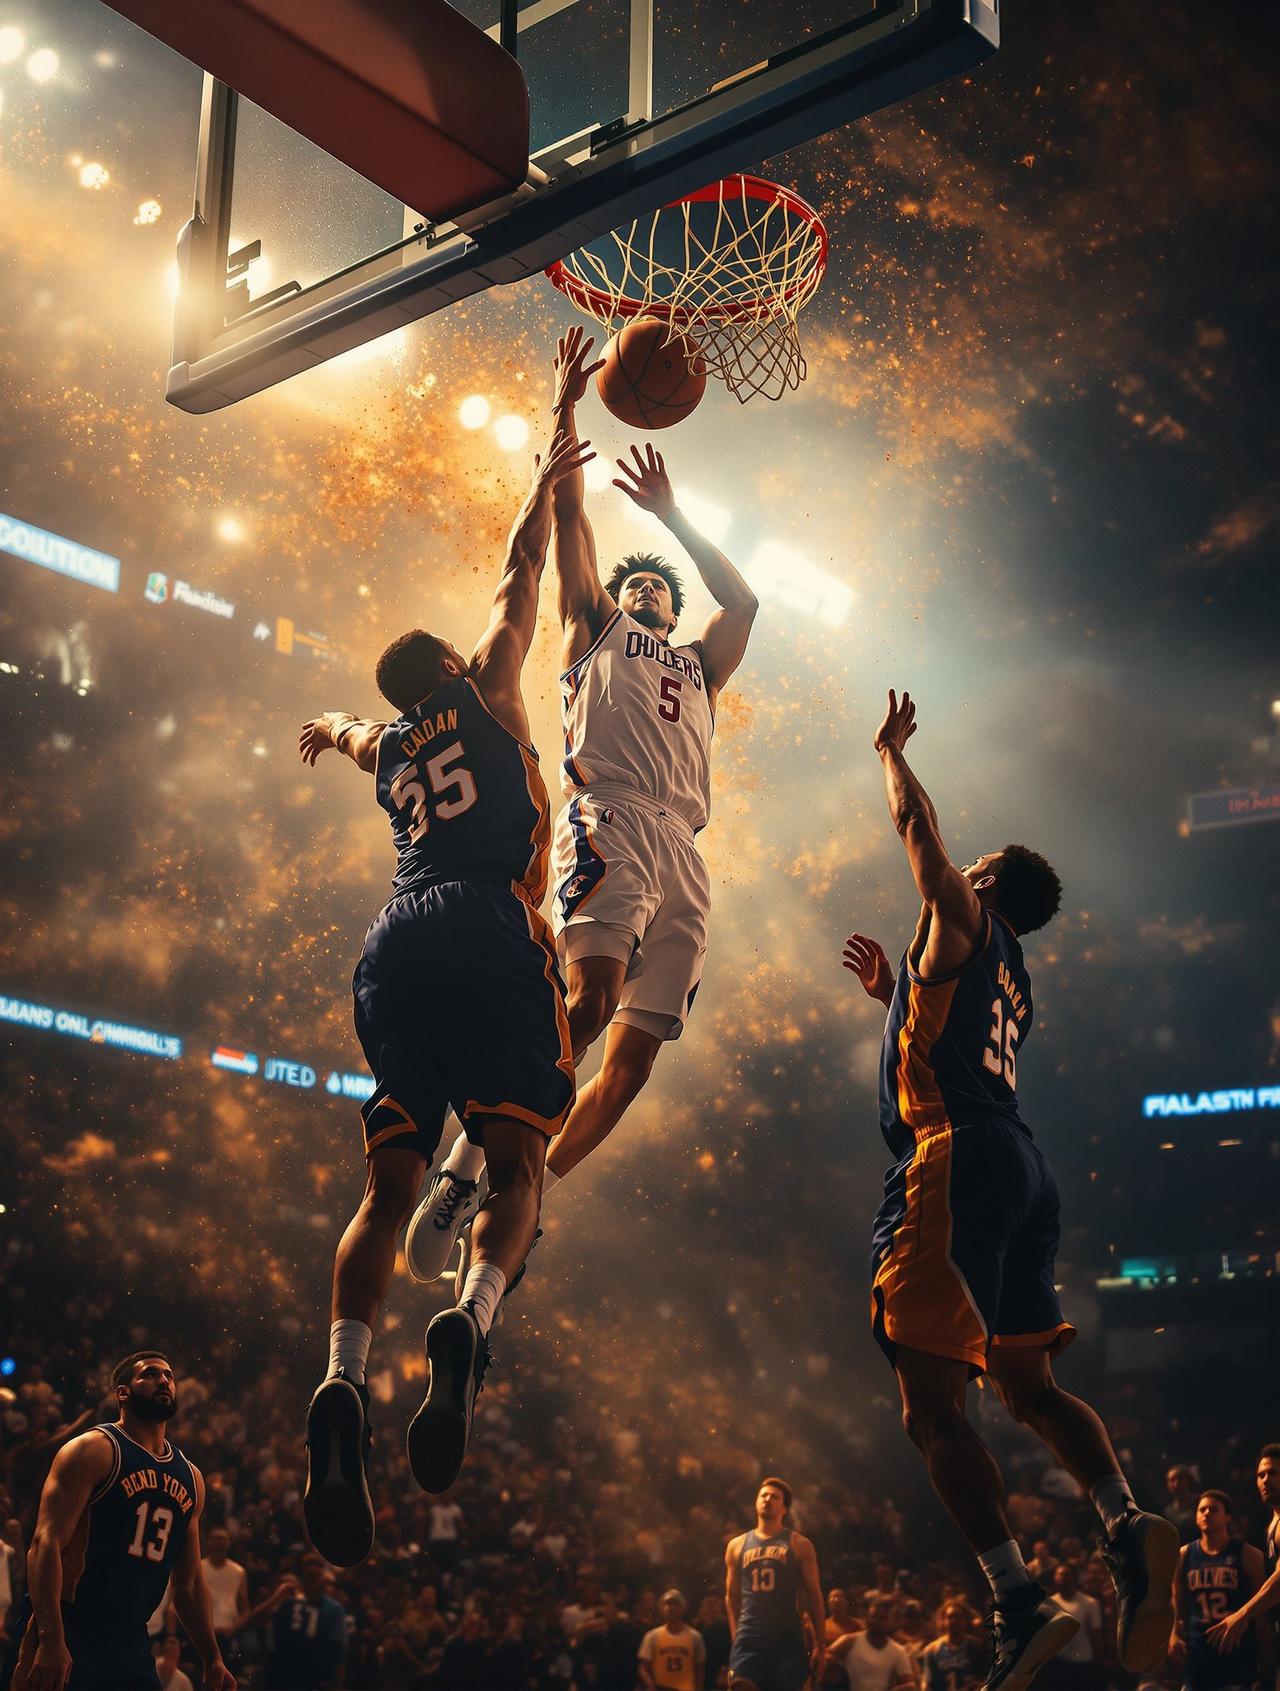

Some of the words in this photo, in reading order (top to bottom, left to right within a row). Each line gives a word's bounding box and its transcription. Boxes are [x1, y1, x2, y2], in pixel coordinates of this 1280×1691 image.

[658, 675, 682, 725] 5
[982, 998, 1019, 1093] 35
[127, 1501, 174, 1562] 13
[1197, 1591, 1232, 1623] 12
